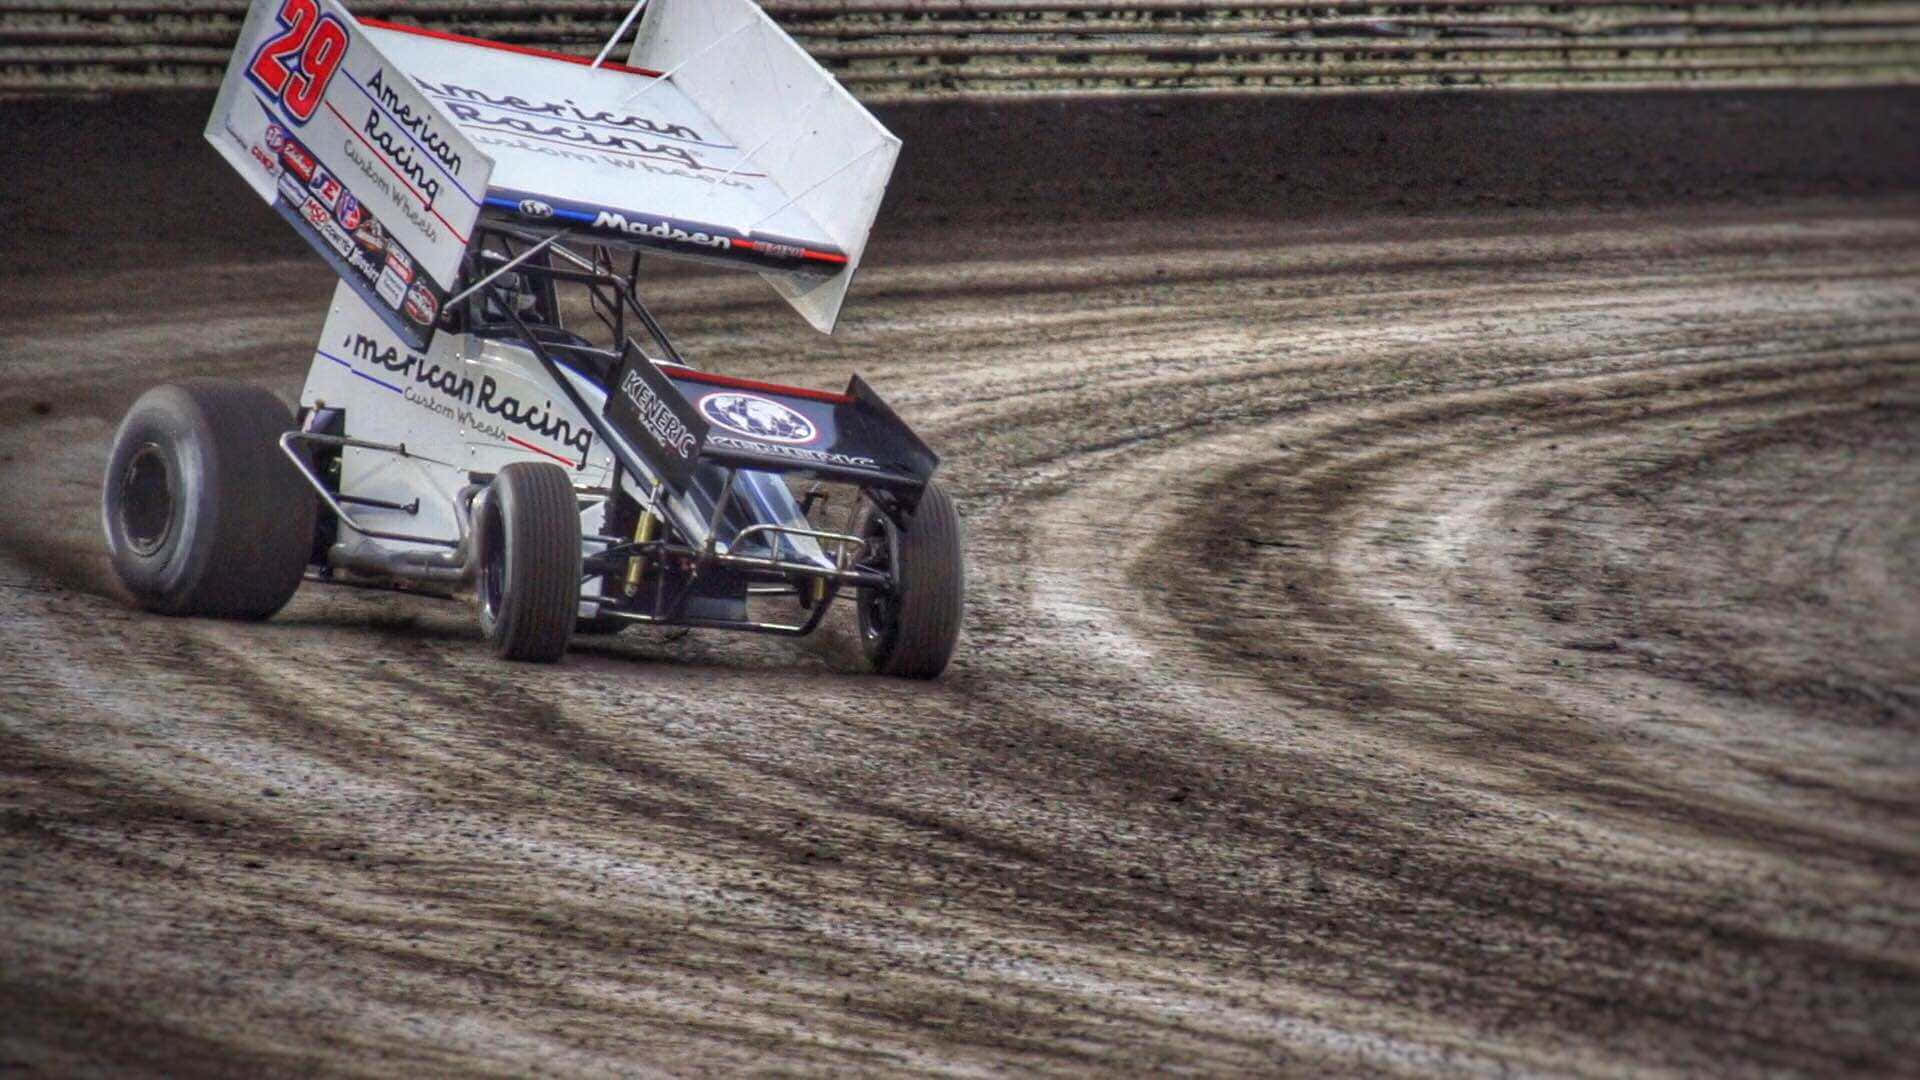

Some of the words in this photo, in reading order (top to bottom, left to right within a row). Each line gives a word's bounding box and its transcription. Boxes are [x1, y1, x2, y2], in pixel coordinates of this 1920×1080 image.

[244, 0, 350, 128] 29
[365, 107, 439, 212] Racing
[367, 67, 461, 176] American
[443, 101, 702, 170] Racing
[470, 133, 597, 163] ustom
[343, 139, 389, 195] Custom
[392, 185, 437, 242] Wheels
[593, 211, 731, 251] Madsen
[343, 333, 474, 405] merican
[477, 375, 592, 472] Racing
[404, 386, 454, 418] Custom
[457, 407, 506, 441] Wheels
[621, 369, 696, 458] KENERIC
